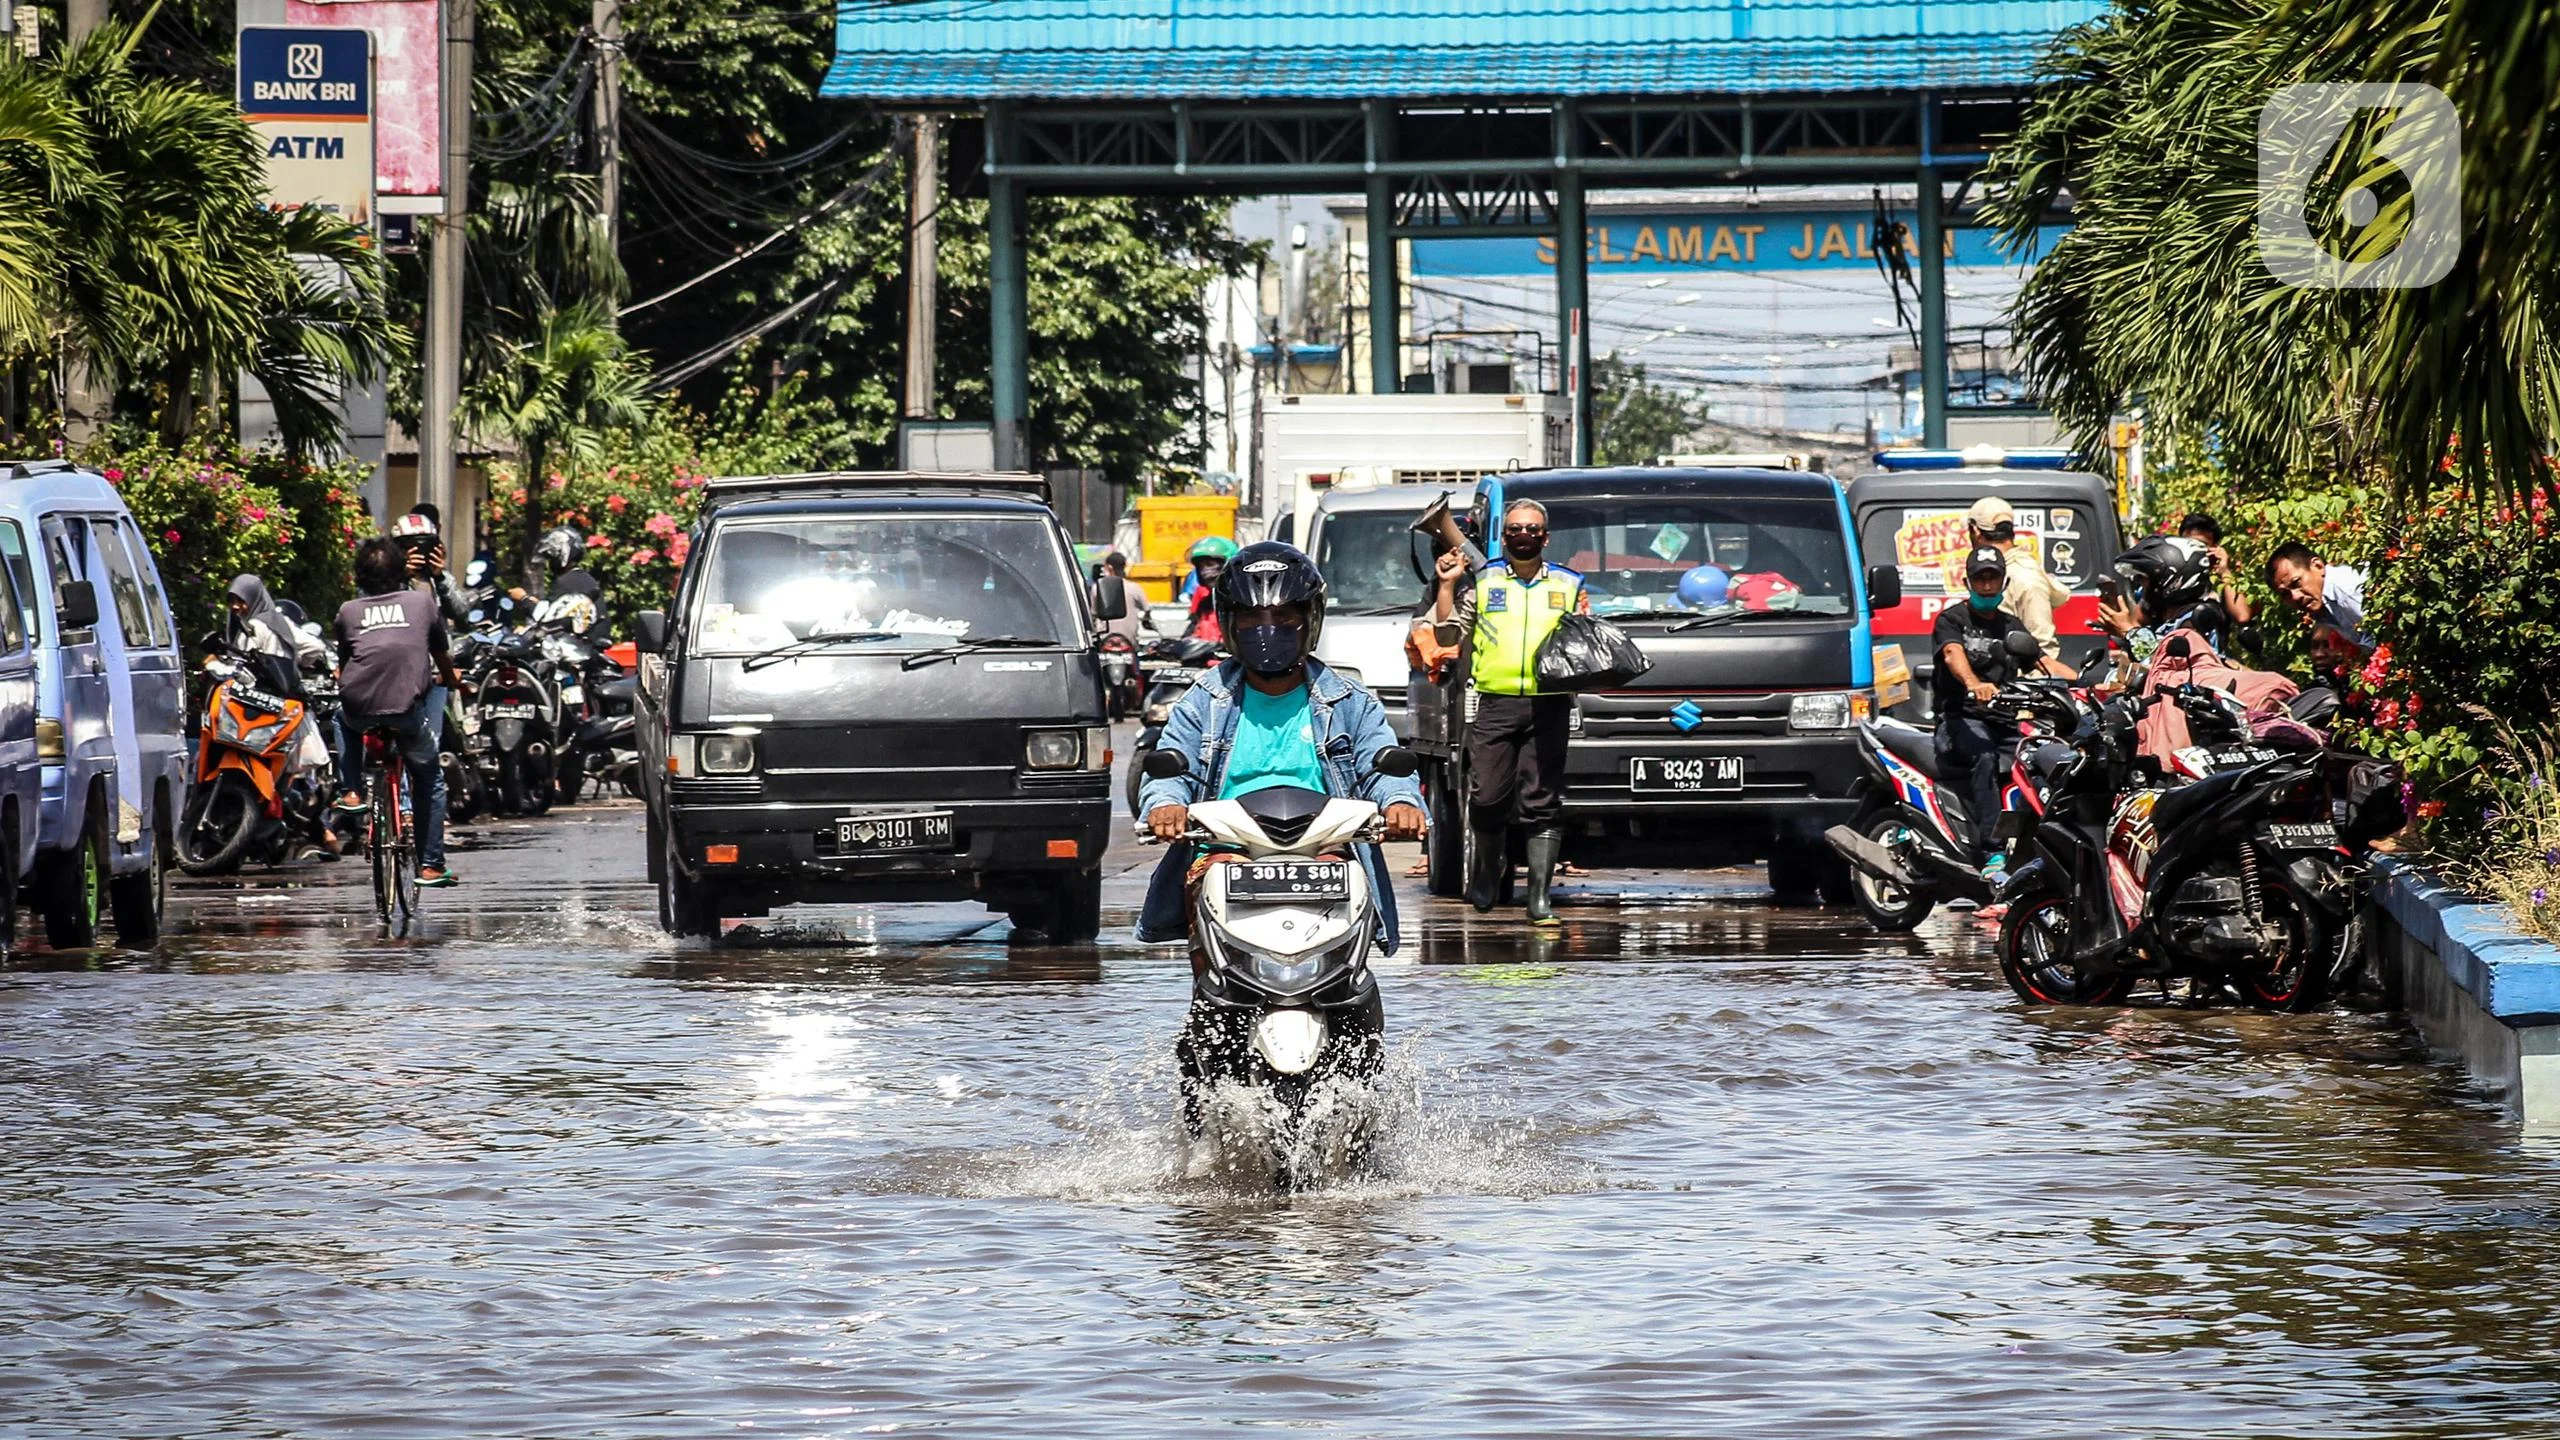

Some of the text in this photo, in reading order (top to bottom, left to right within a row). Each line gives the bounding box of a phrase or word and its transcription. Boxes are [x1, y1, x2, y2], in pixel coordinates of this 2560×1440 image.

[254, 81, 316, 100] BANK
[320, 82, 356, 101] BRI
[267, 136, 344, 160] ATM
[361, 603, 405, 627] JAVA
[983, 661, 1052, 672] COLT
[1635, 758, 1738, 780] A 8343 AM
[876, 820, 912, 839] 8101
[925, 818, 949, 836] RM
[1230, 866, 1242, 881] B
[1252, 865, 1299, 880] 3012
